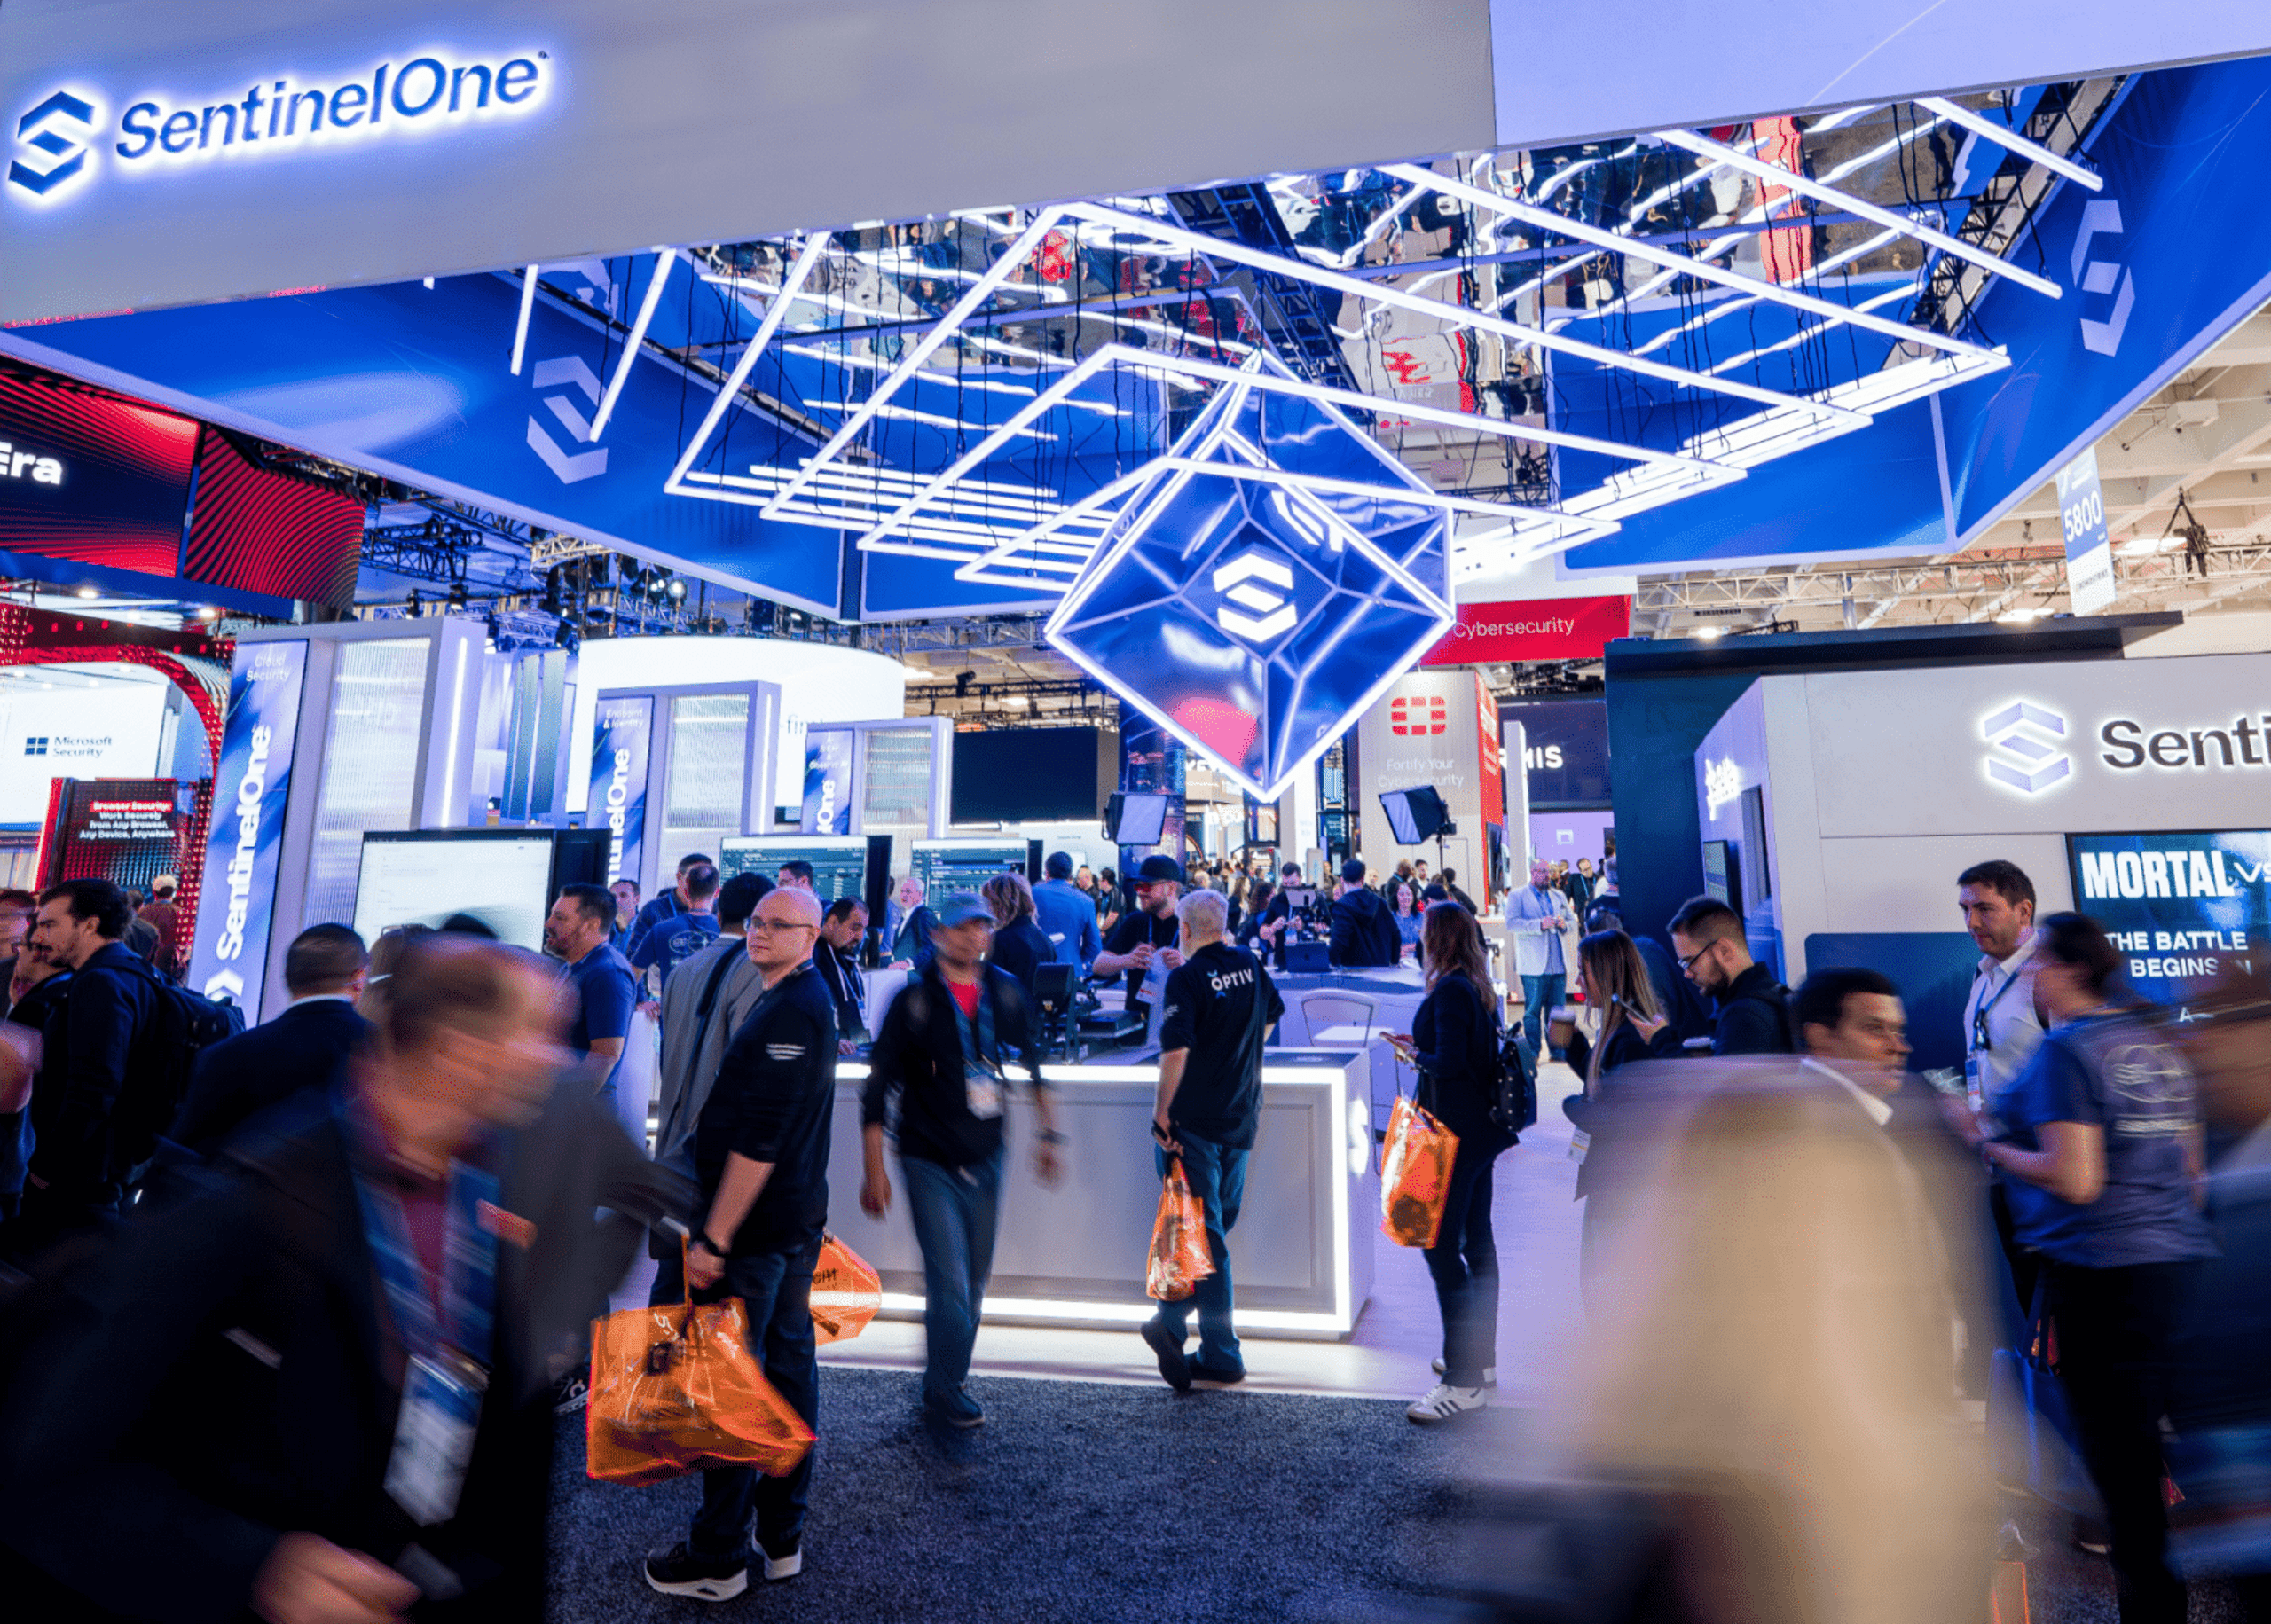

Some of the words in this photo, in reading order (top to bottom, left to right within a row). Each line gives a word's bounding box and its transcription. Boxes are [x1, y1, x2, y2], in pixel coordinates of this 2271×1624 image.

[116, 57, 539, 159] SentinelOne
[2063, 490, 2102, 543] 5800
[1453, 617, 1575, 640] Cybersecurity
[246, 667, 291, 682] Security
[54, 735, 112, 746] Microsoft
[53, 747, 104, 758] Security
[1386, 758, 1425, 773] Fortify
[1428, 759, 1455, 770] Your
[79, 829, 97, 840] Any
[112, 820, 130, 830] Any
[216, 724, 272, 961] SentinelOne
[2080, 850, 2236, 898] MORTAL
[2154, 930, 2249, 951] BATTLE
[2130, 957, 2218, 977] BEGINS
[1211, 969, 1254, 991] OPTIV
